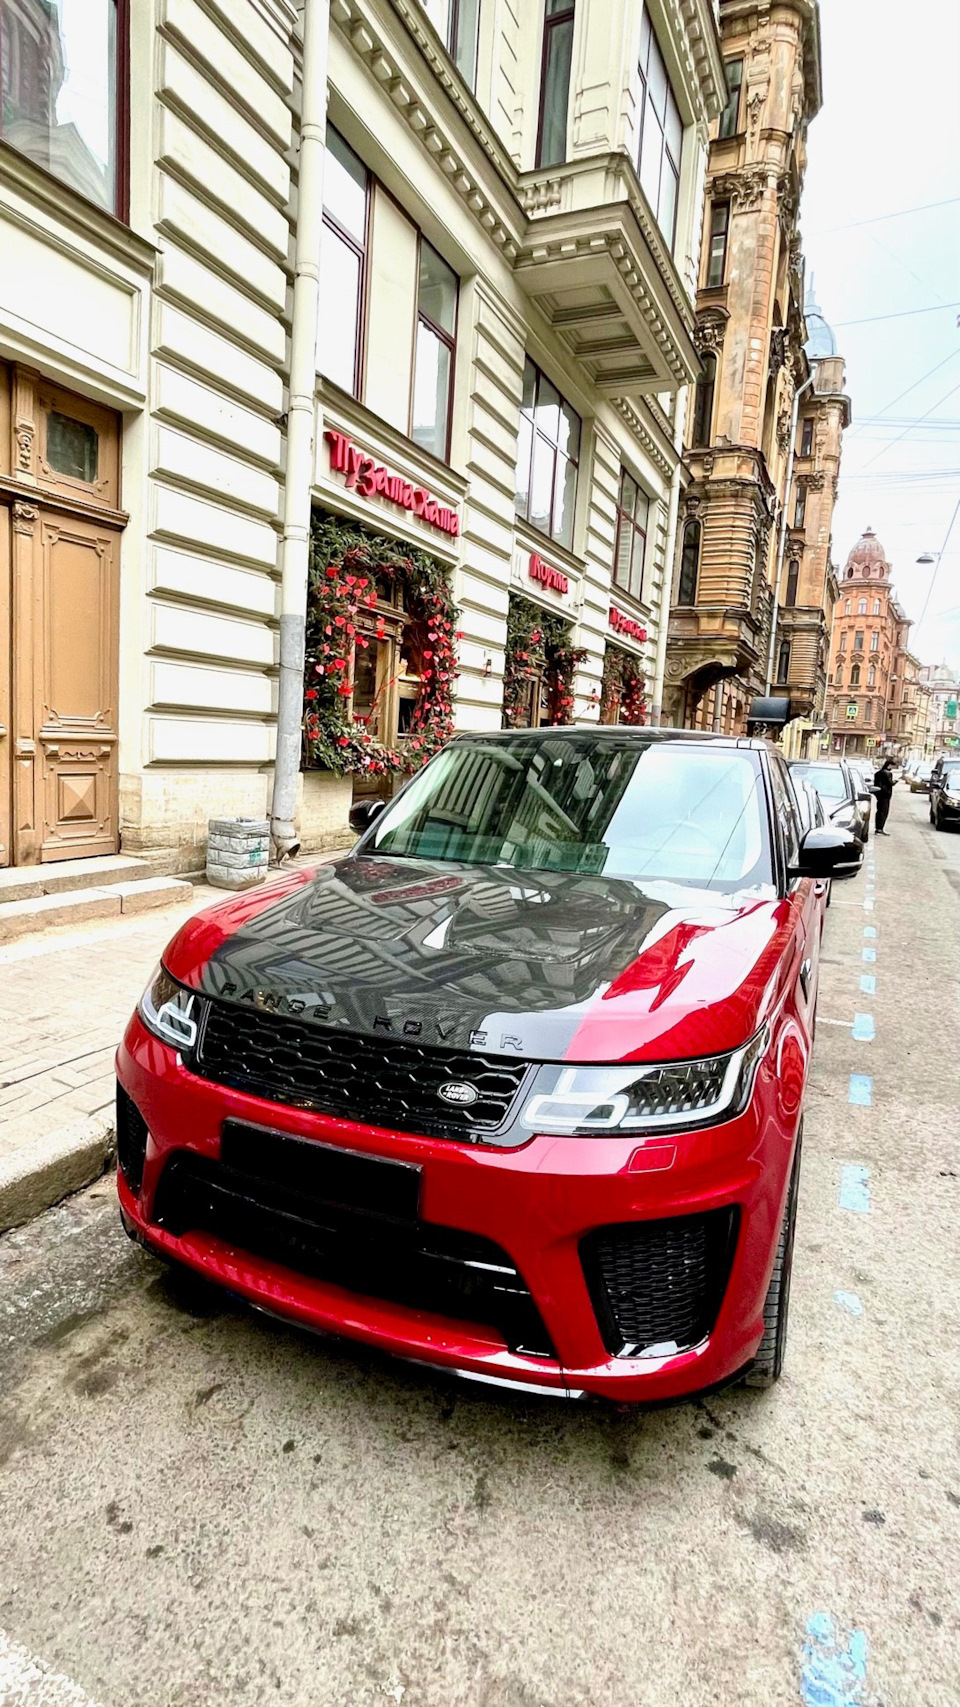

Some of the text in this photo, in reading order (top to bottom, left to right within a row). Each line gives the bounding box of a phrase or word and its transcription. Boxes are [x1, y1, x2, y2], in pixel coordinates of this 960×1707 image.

[220, 981, 523, 1051] RANGE ROVER
[445, 1085, 465, 1093] LAND
[445, 1091, 470, 1101] ROVER
